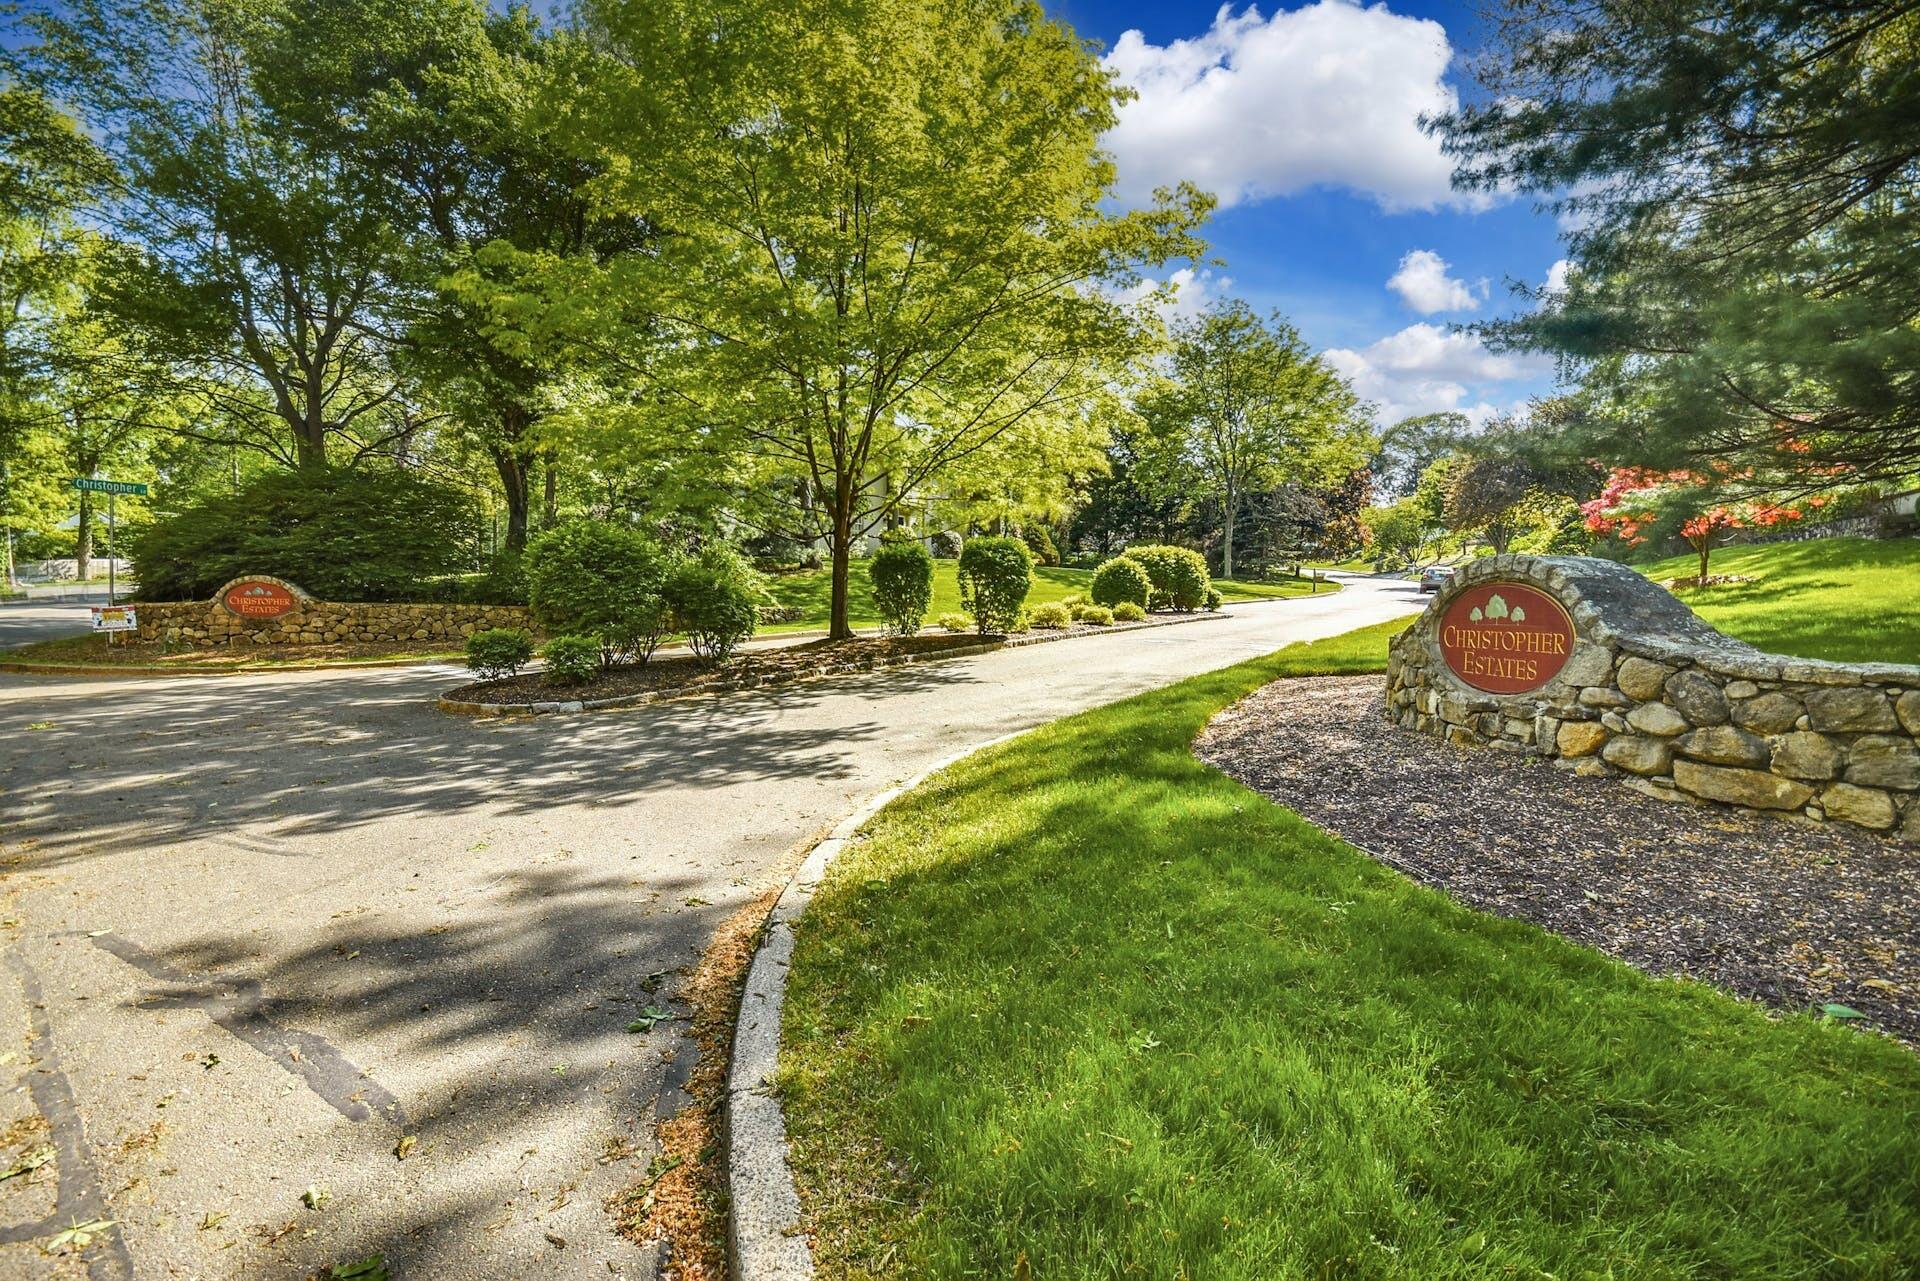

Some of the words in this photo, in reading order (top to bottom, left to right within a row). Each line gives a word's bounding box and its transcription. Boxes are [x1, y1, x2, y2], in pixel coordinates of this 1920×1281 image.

[76, 478, 137, 493] Christopher
[229, 596, 290, 606] CHRISTOPHER
[242, 604, 280, 613] ESTATES
[1443, 625, 1565, 655] CHRISTOPHER
[1462, 651, 1537, 681] ESTATES
